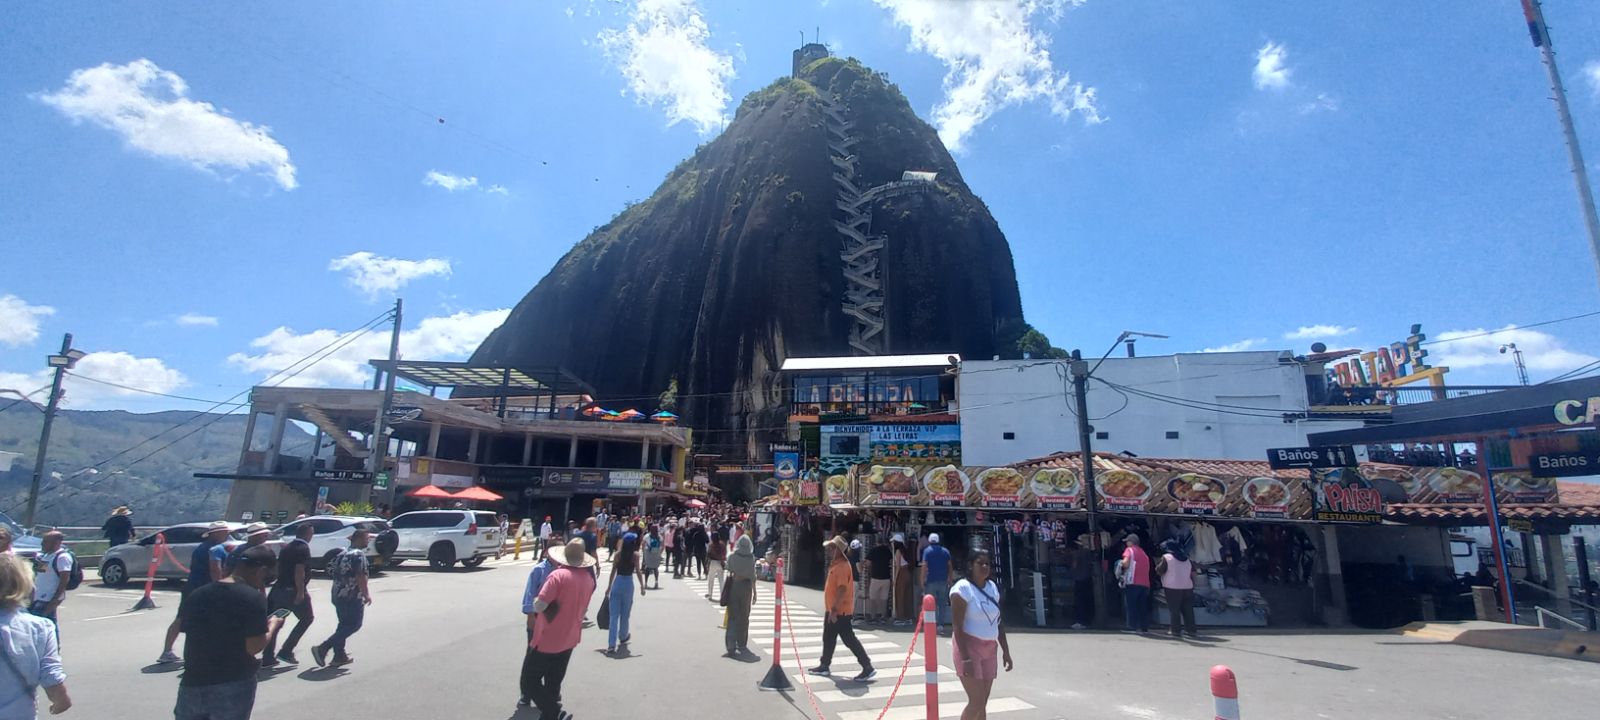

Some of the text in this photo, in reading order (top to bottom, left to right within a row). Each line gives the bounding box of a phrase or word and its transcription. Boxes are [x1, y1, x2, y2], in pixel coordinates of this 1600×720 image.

[834, 425, 873, 433] BIENVENIDOS
[1277, 449, 1319, 461] Baños
[1539, 454, 1587, 468] Baños
[1318, 513, 1382, 522] RESTAURANTE
